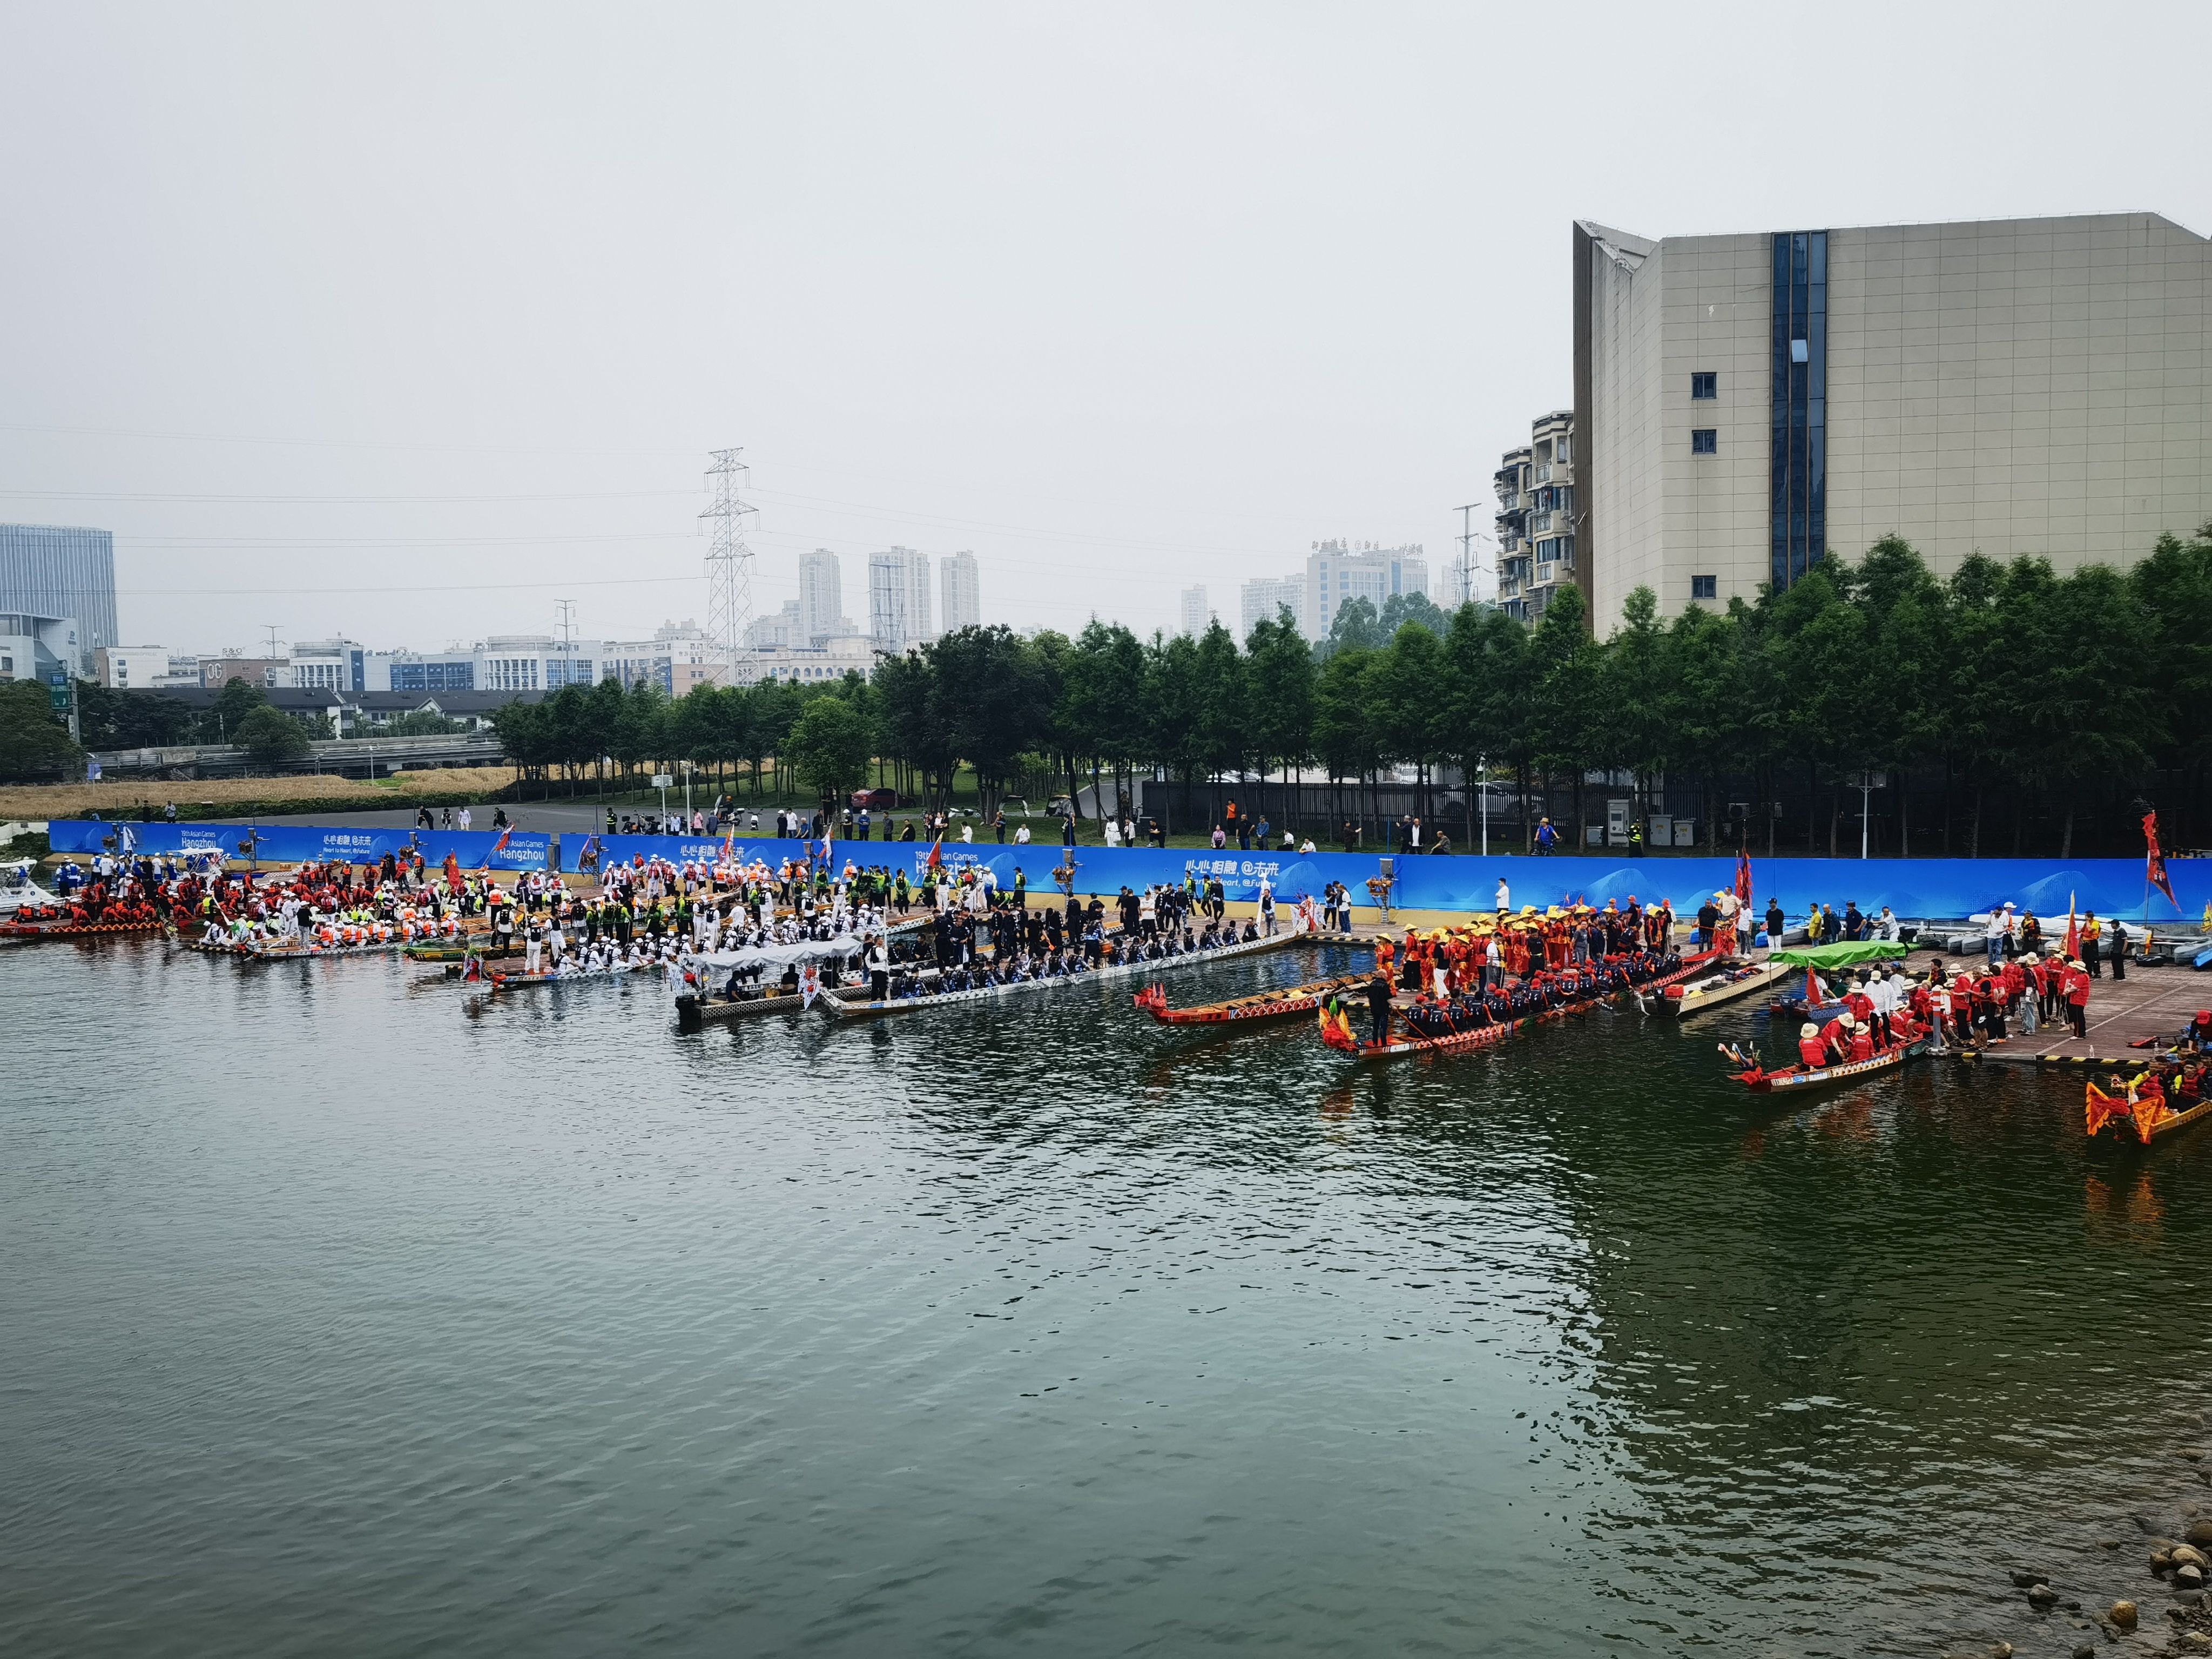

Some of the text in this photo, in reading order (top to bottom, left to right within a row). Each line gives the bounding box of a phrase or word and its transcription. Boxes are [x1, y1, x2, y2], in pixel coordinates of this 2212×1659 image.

[181, 837, 216, 848] Hangzhou
[511, 839, 525, 847] Asian
[526, 840, 544, 848] Games
[500, 847, 545, 862] Hangzhou
[953, 852, 978, 862] Games
